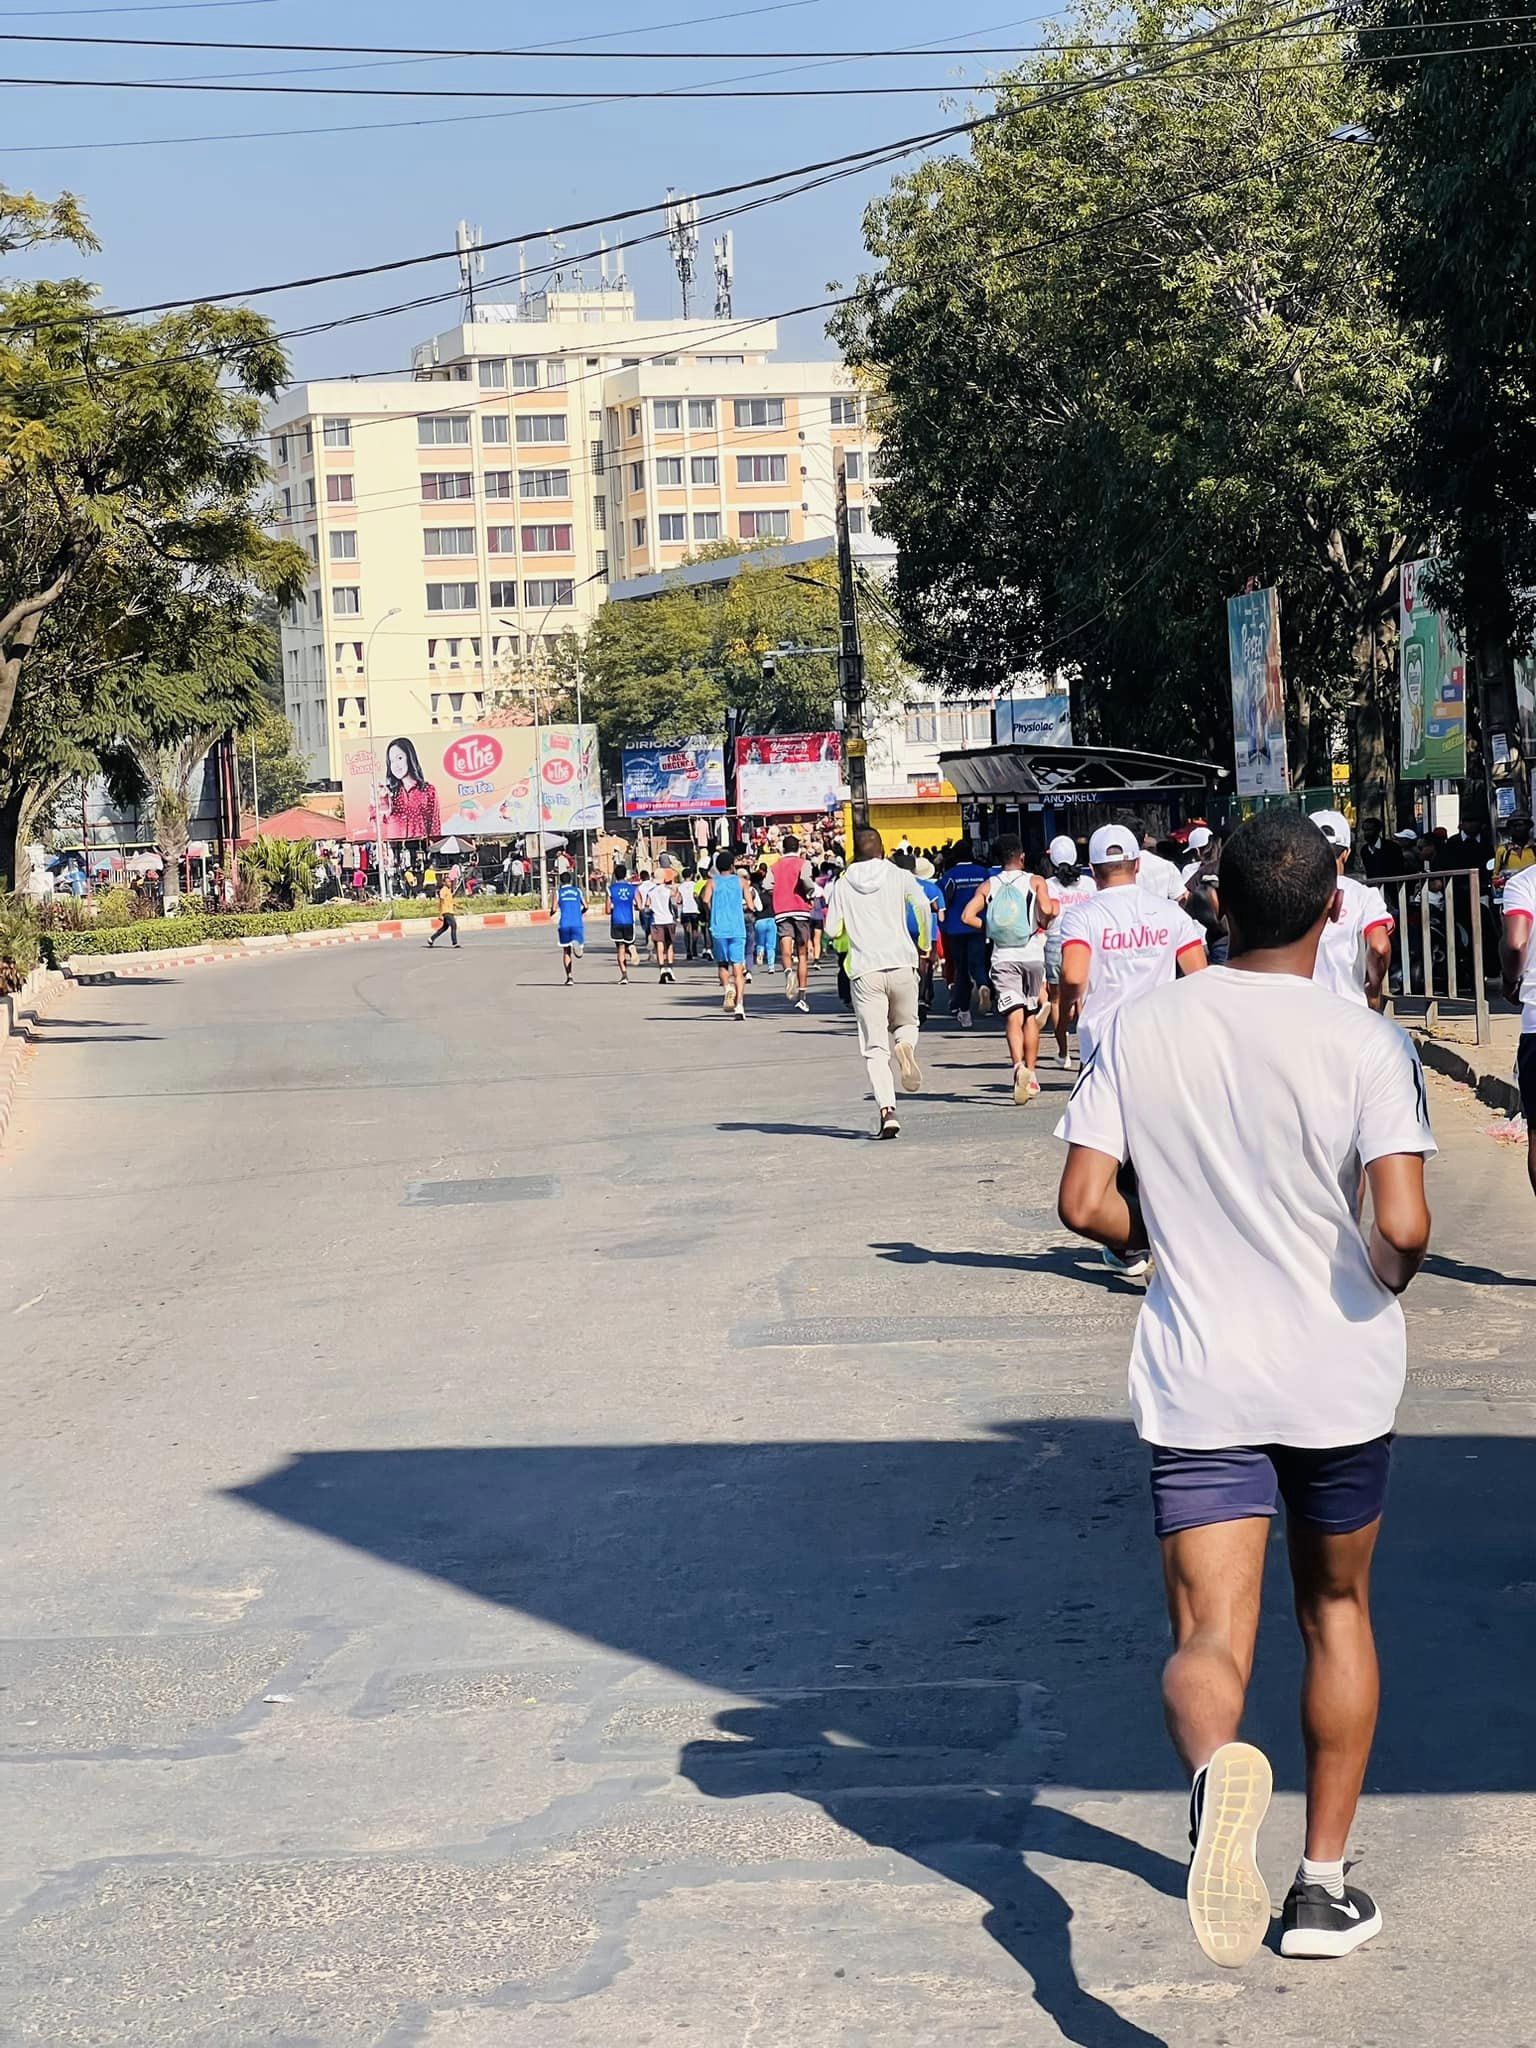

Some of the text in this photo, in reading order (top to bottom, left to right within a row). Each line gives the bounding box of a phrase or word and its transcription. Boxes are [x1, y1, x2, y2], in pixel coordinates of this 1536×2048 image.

[1014, 721, 1054, 733] Physiolac
[453, 739, 495, 773] LeThé
[1043, 792, 1097, 803] ANOSIKELY
[1102, 925, 1169, 950] EauVive
